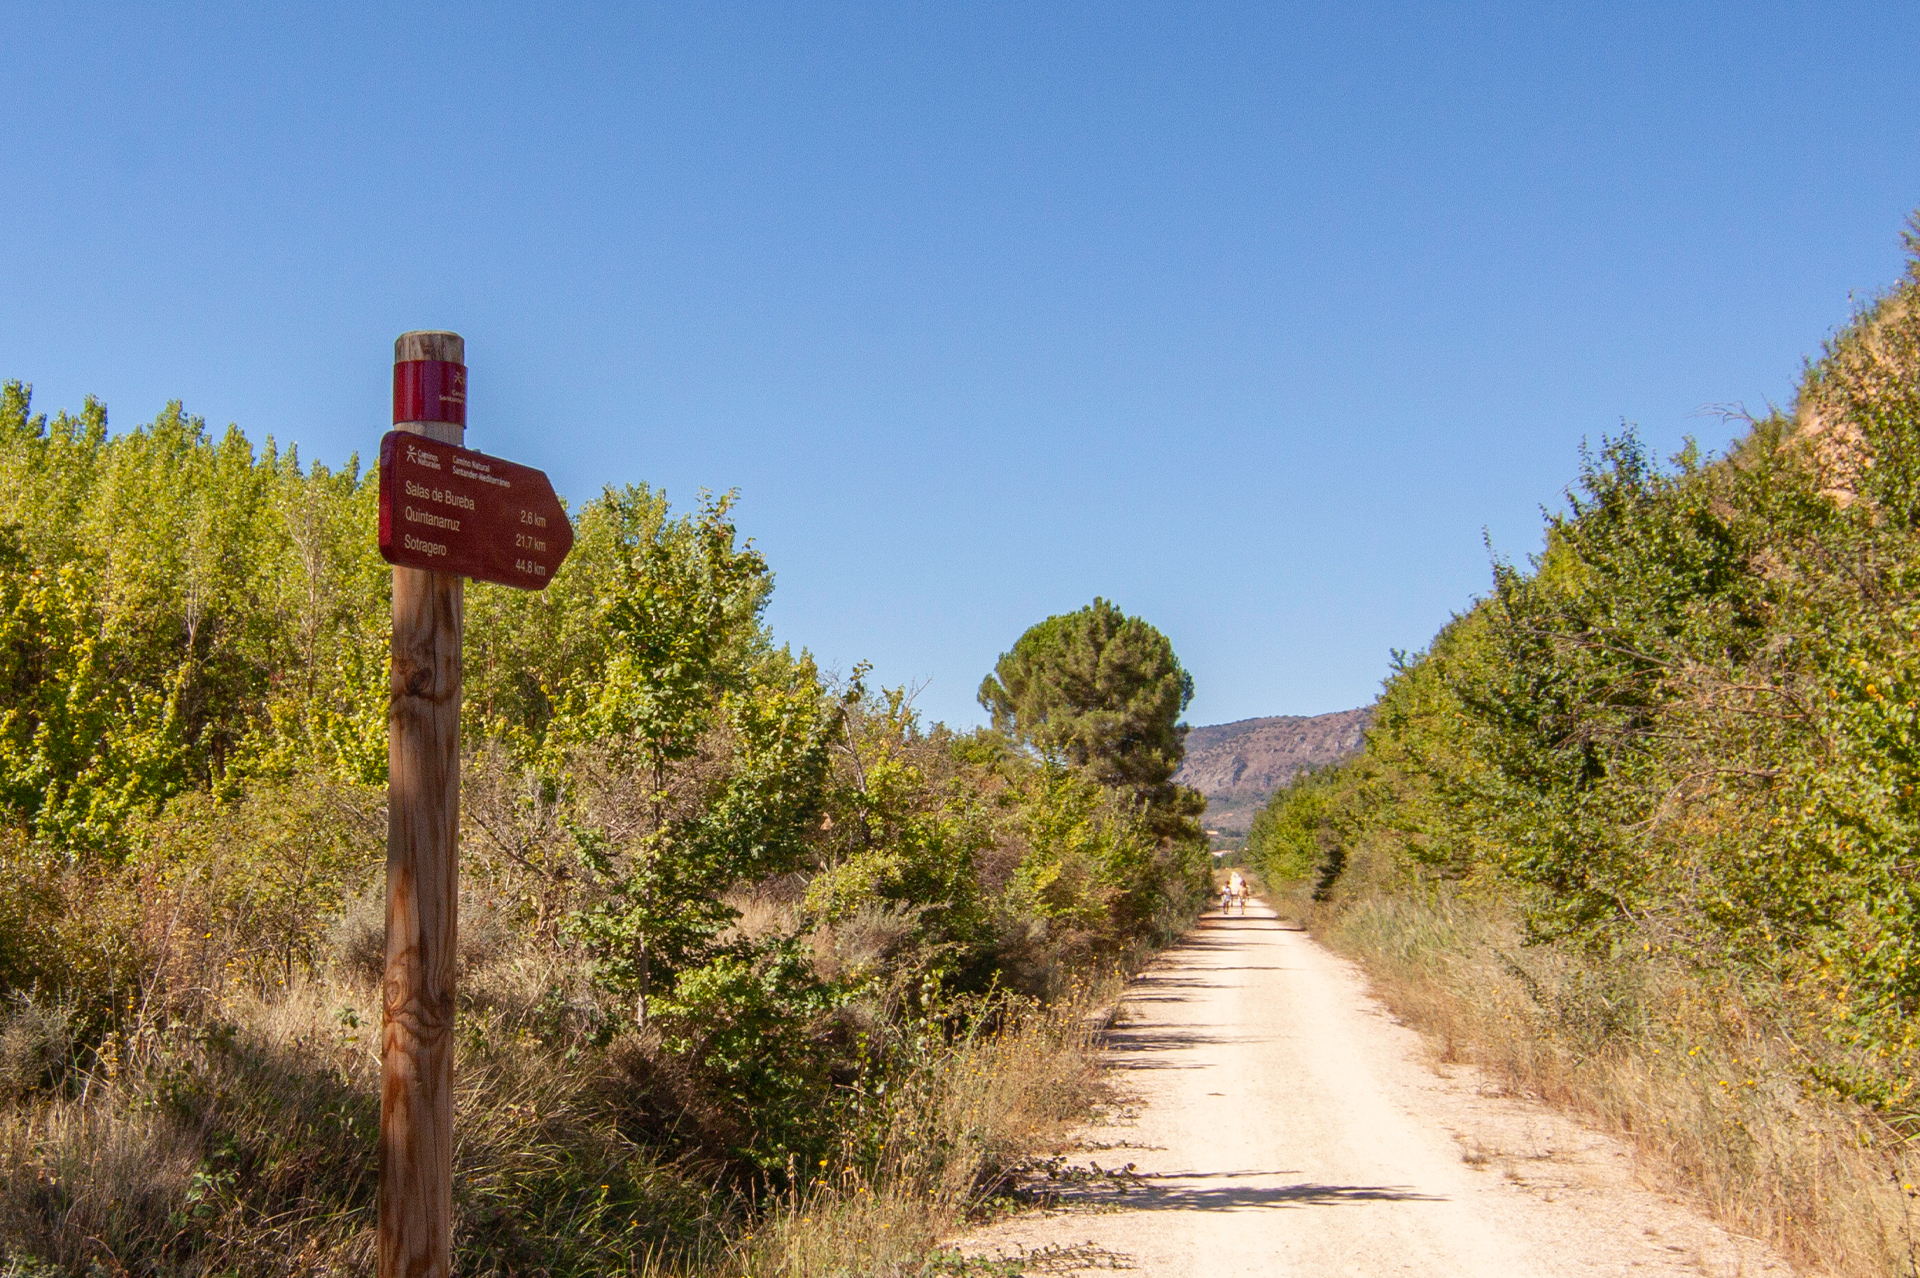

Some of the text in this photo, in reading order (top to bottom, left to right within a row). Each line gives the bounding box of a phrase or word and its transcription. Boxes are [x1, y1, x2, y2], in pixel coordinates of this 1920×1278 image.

[405, 480, 430, 499] Salas
[432, 487, 443, 502] de
[445, 491, 475, 510] Bureba
[534, 512, 546, 527] km
[405, 506, 460, 532] Quintanarruz
[534, 537, 546, 552] km
[404, 535, 447, 557] Sotragero
[534, 561, 546, 576] km
